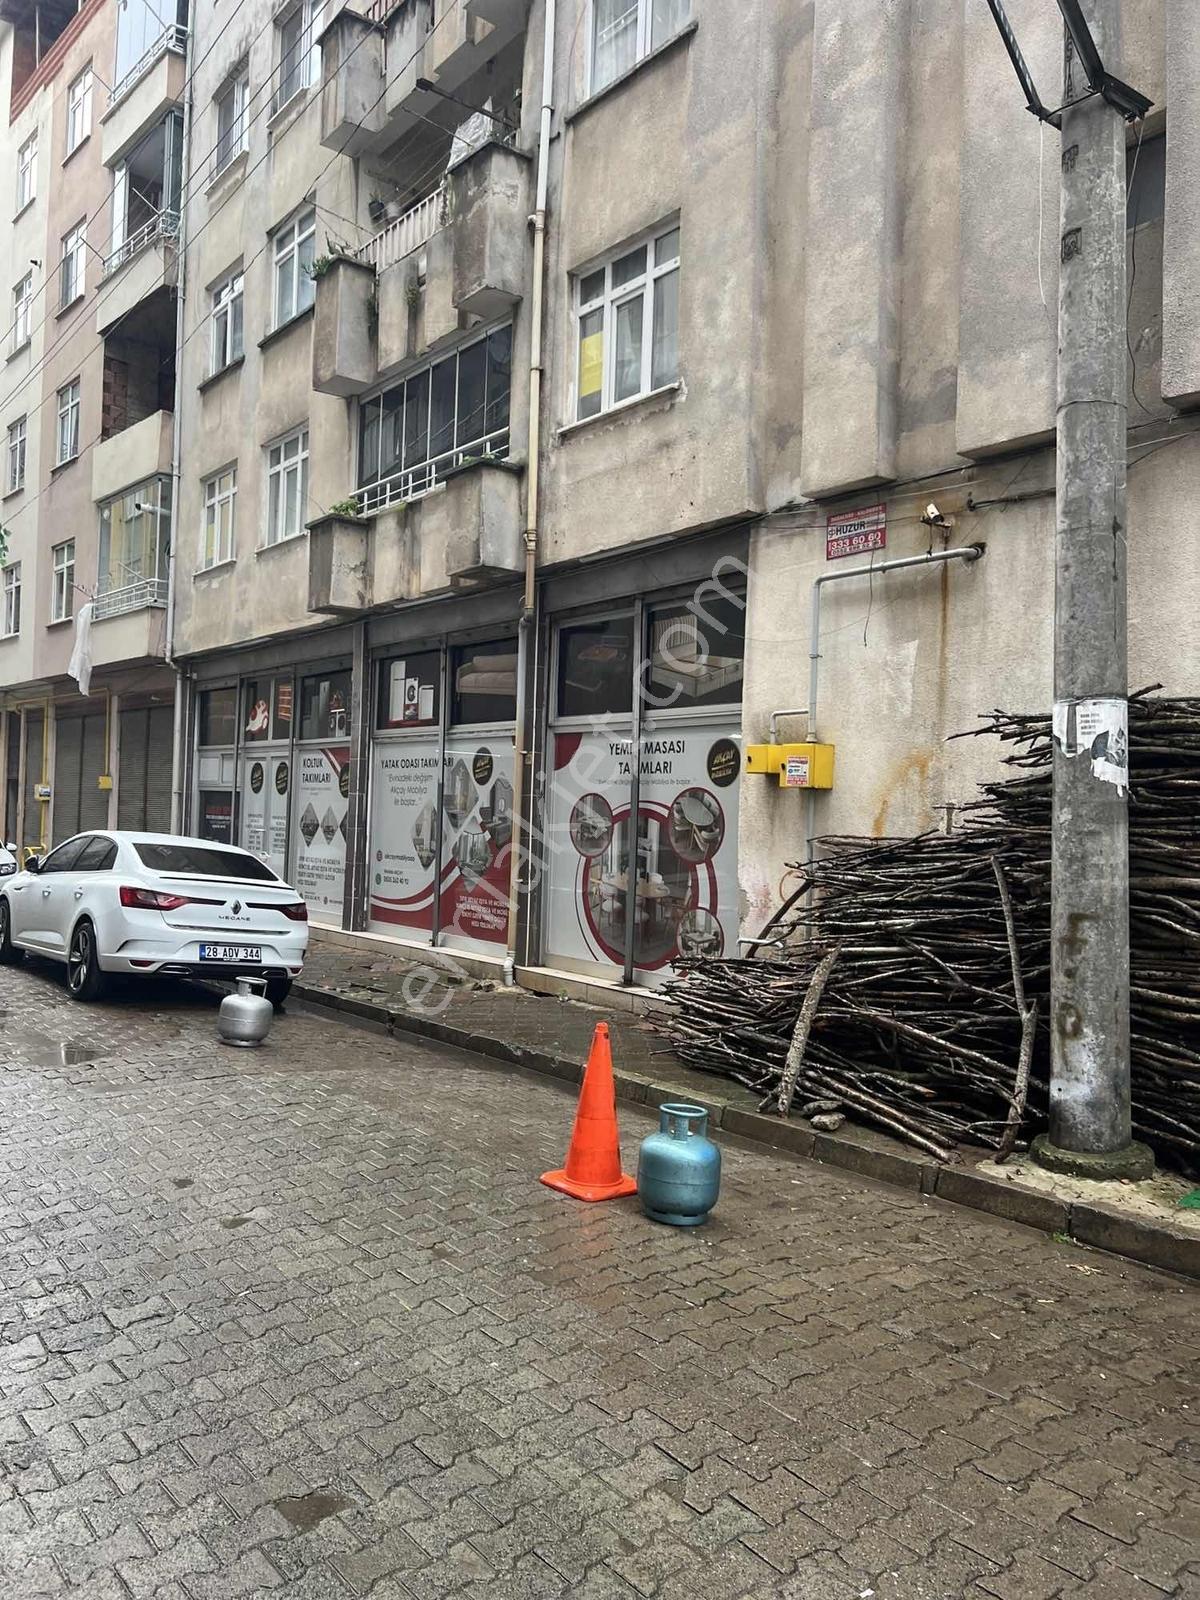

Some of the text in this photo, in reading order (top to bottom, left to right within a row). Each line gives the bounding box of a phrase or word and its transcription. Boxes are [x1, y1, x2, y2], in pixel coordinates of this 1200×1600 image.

[836, 521, 866, 536] HUZUR
[831, 538, 850, 550] 333
[852, 535, 865, 545] 60
[868, 531, 881, 541] 60
[644, 740, 685, 755] MASASI
[303, 758, 324, 768] KOLTUK
[381, 756, 454, 769] YATAK ODASI TAKIMARI
[618, 761, 672, 776] TAMLARI
[302, 773, 331, 783] TAKIMLARI
[206, 946, 260, 959] 28 ADV 344
